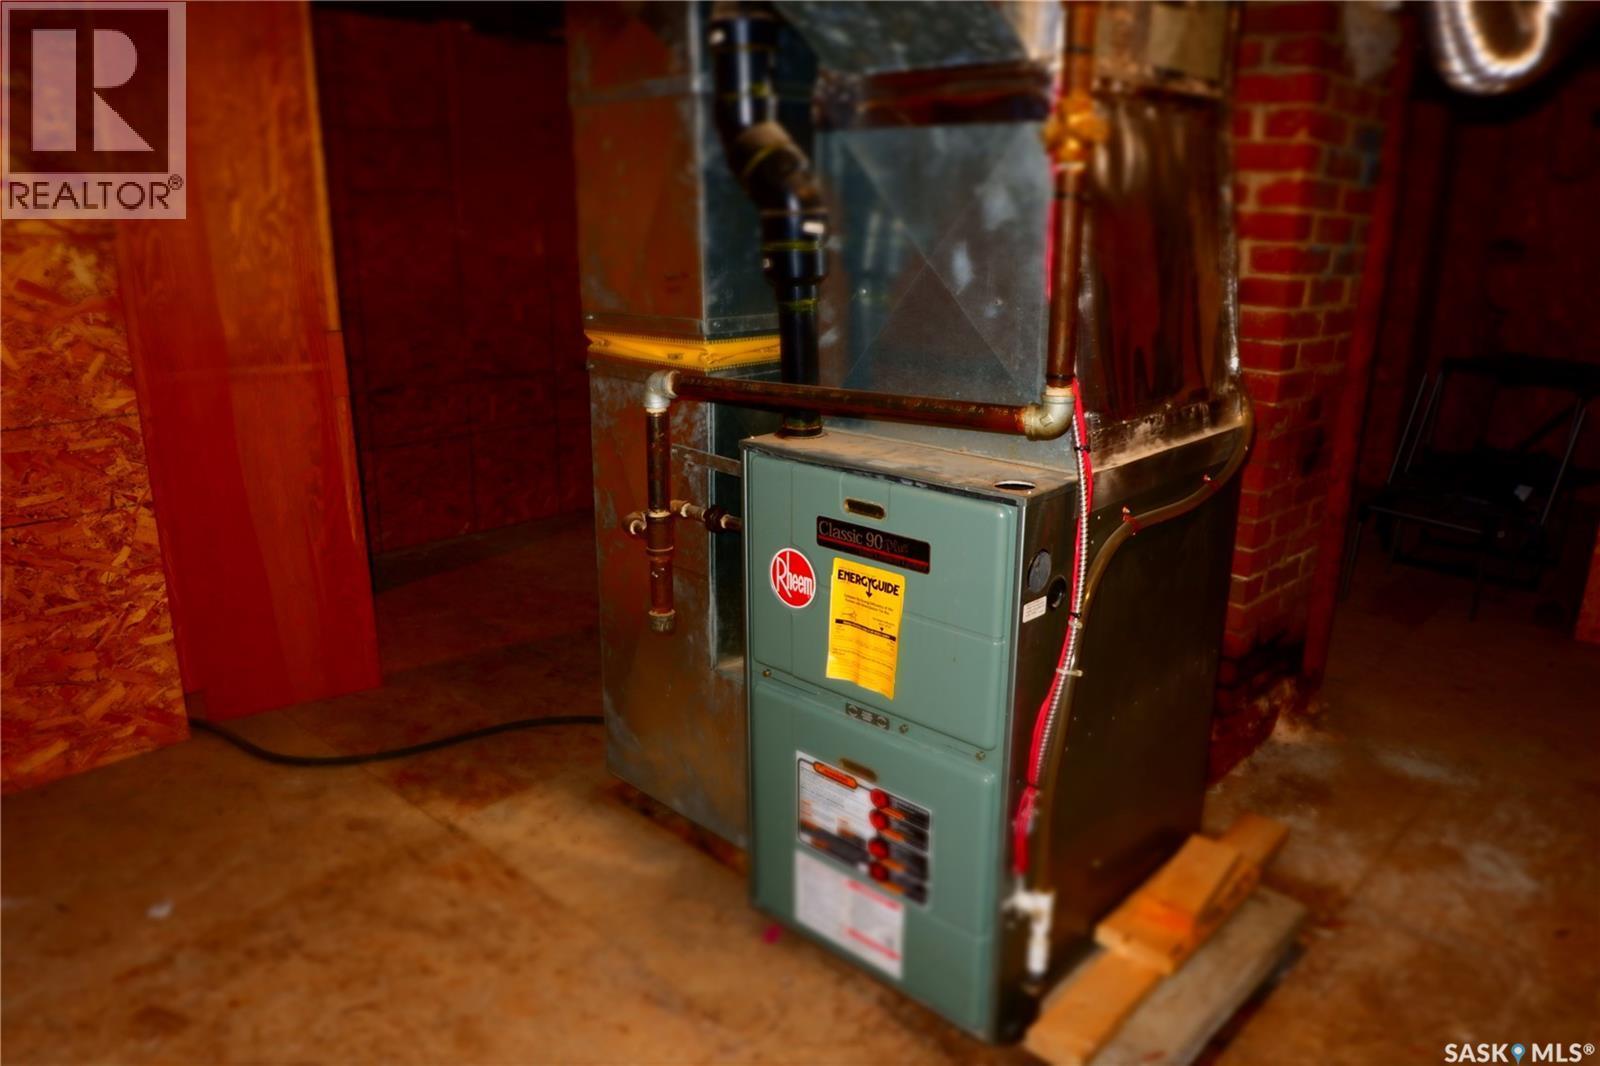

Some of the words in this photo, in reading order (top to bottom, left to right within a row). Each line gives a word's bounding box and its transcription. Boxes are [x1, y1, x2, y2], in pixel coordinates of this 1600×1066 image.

[818, 519, 863, 545] Classic
[865, 531, 884, 550] 90
[775, 551, 814, 598] Rheem
[837, 569, 900, 597] ENERGYGUIDE
